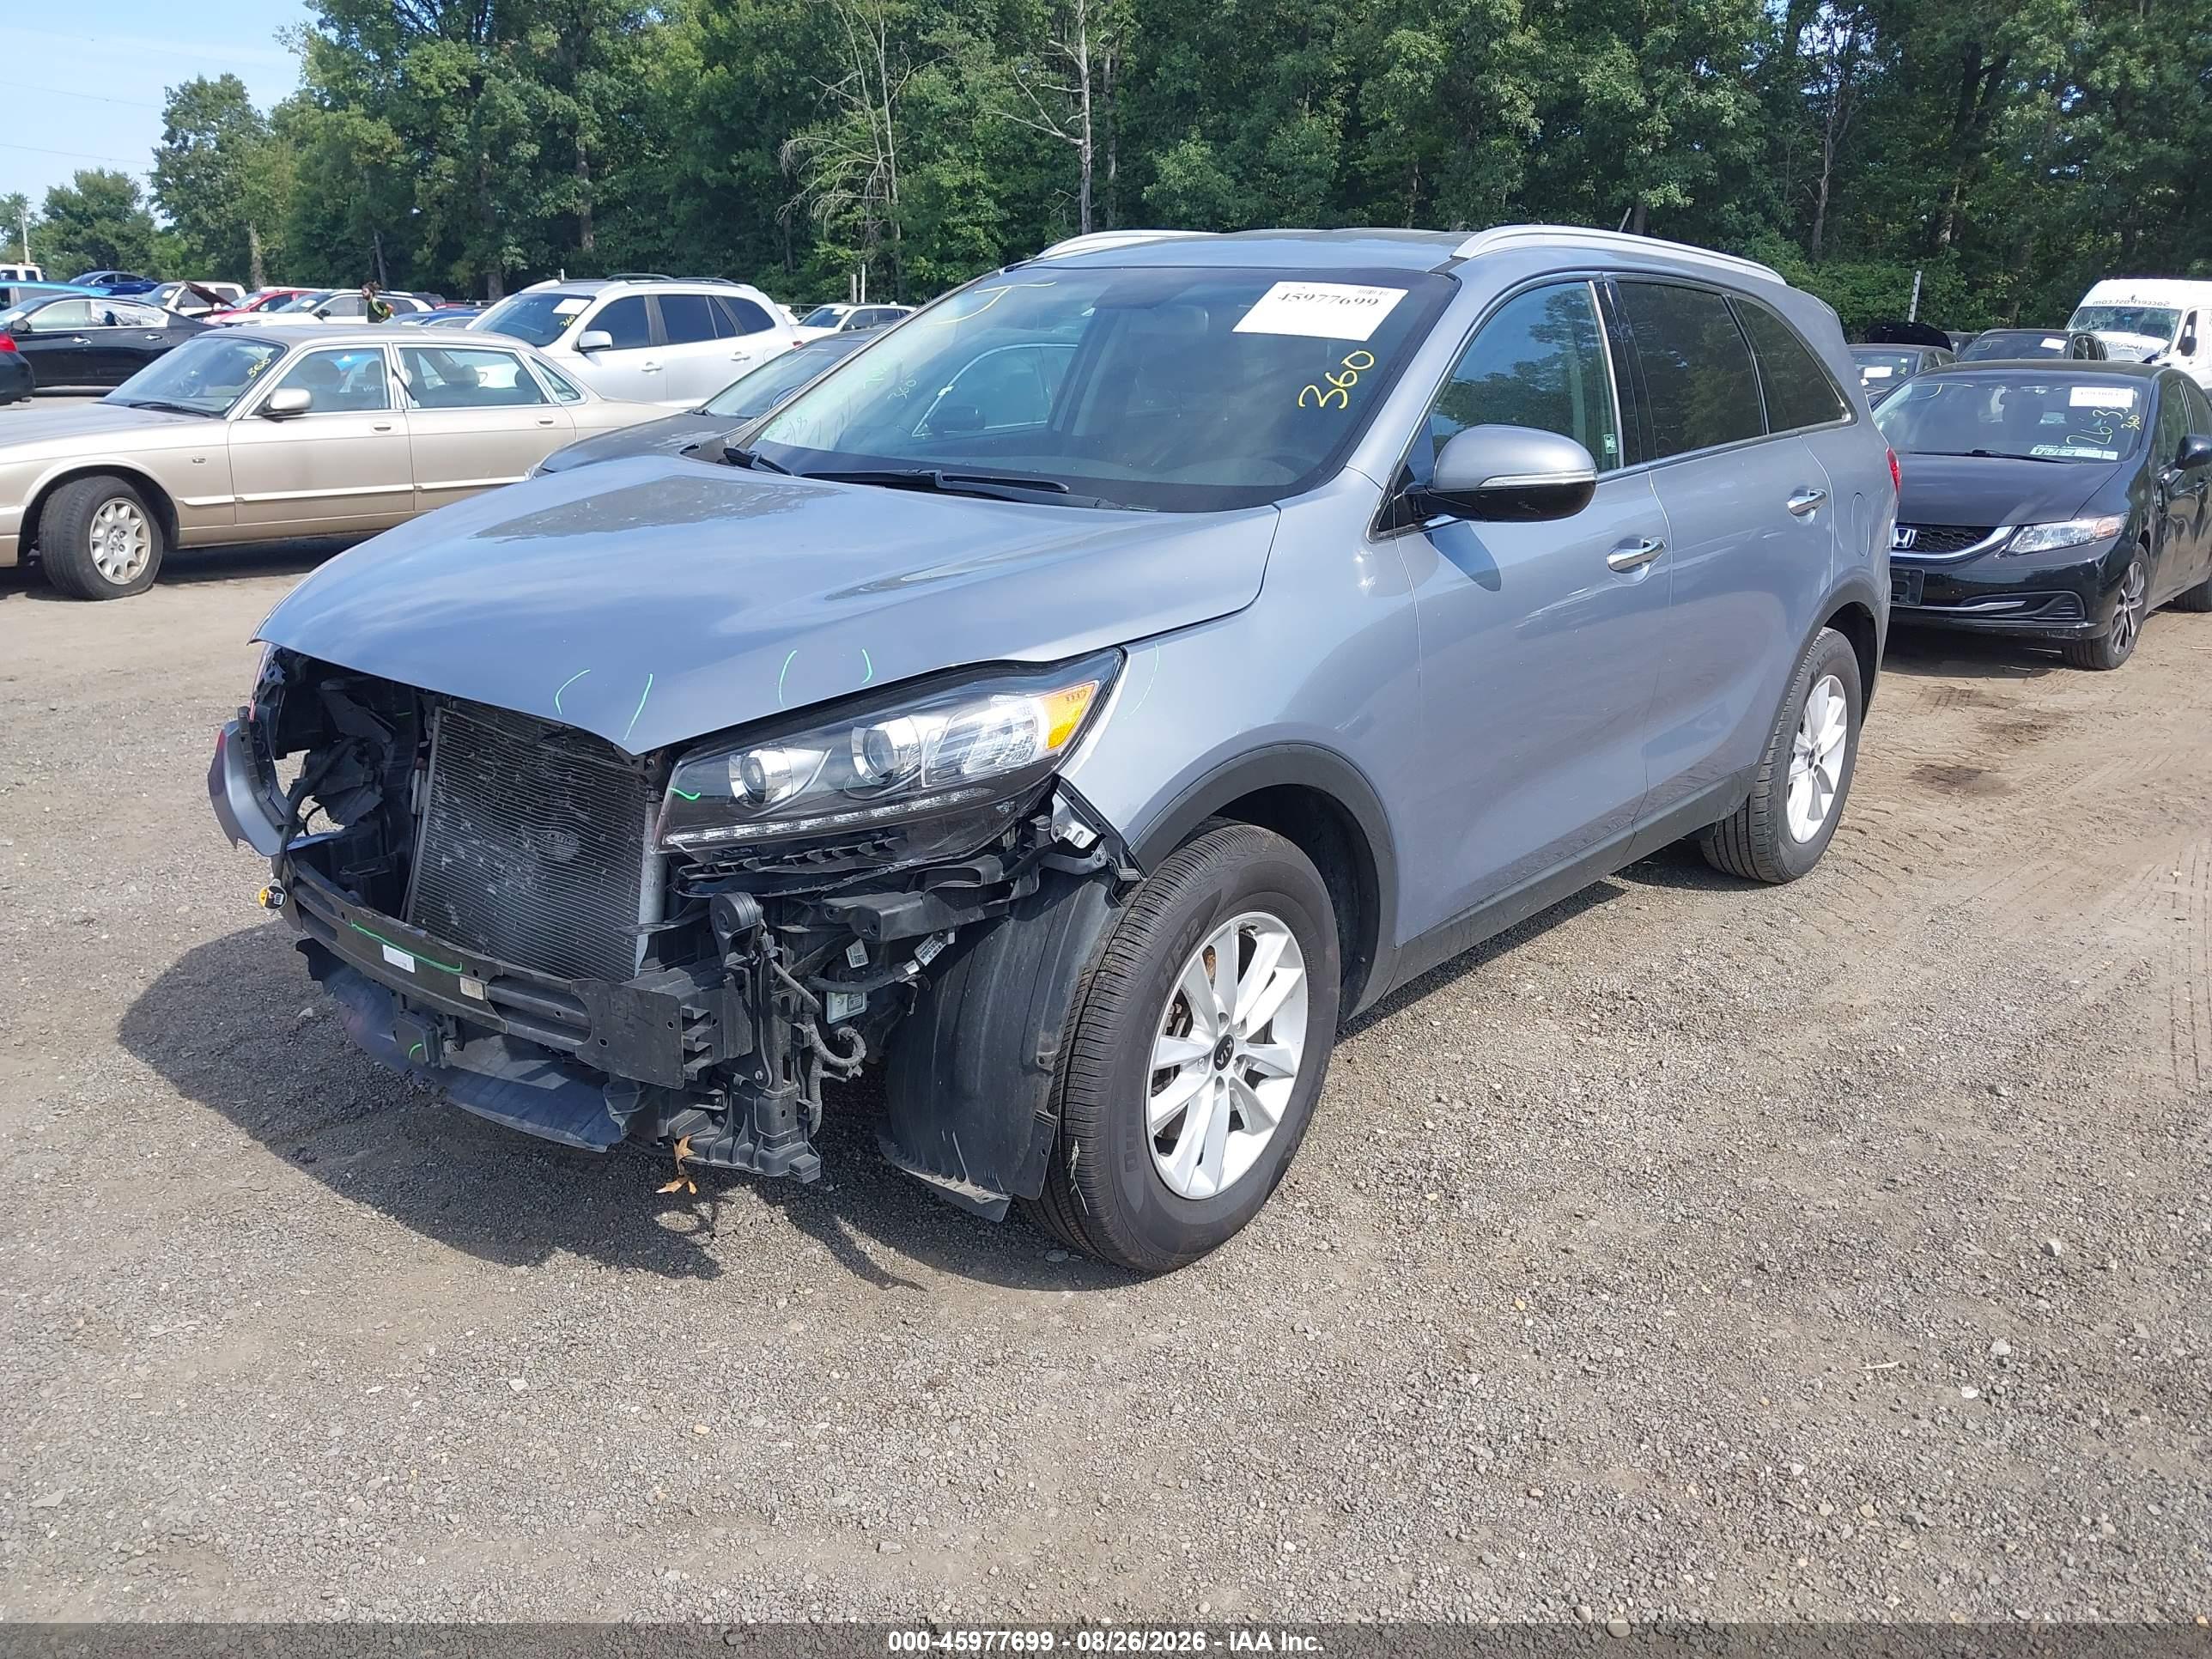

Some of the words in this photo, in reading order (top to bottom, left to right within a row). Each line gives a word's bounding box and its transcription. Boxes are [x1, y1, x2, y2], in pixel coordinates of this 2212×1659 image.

[1277, 292, 1380, 307] 45977699
[247, 357, 272, 378] 360
[1297, 349, 1375, 409] 360
[2120, 415, 2141, 430] 360
[1215, 1039, 1233, 1065] KIA
